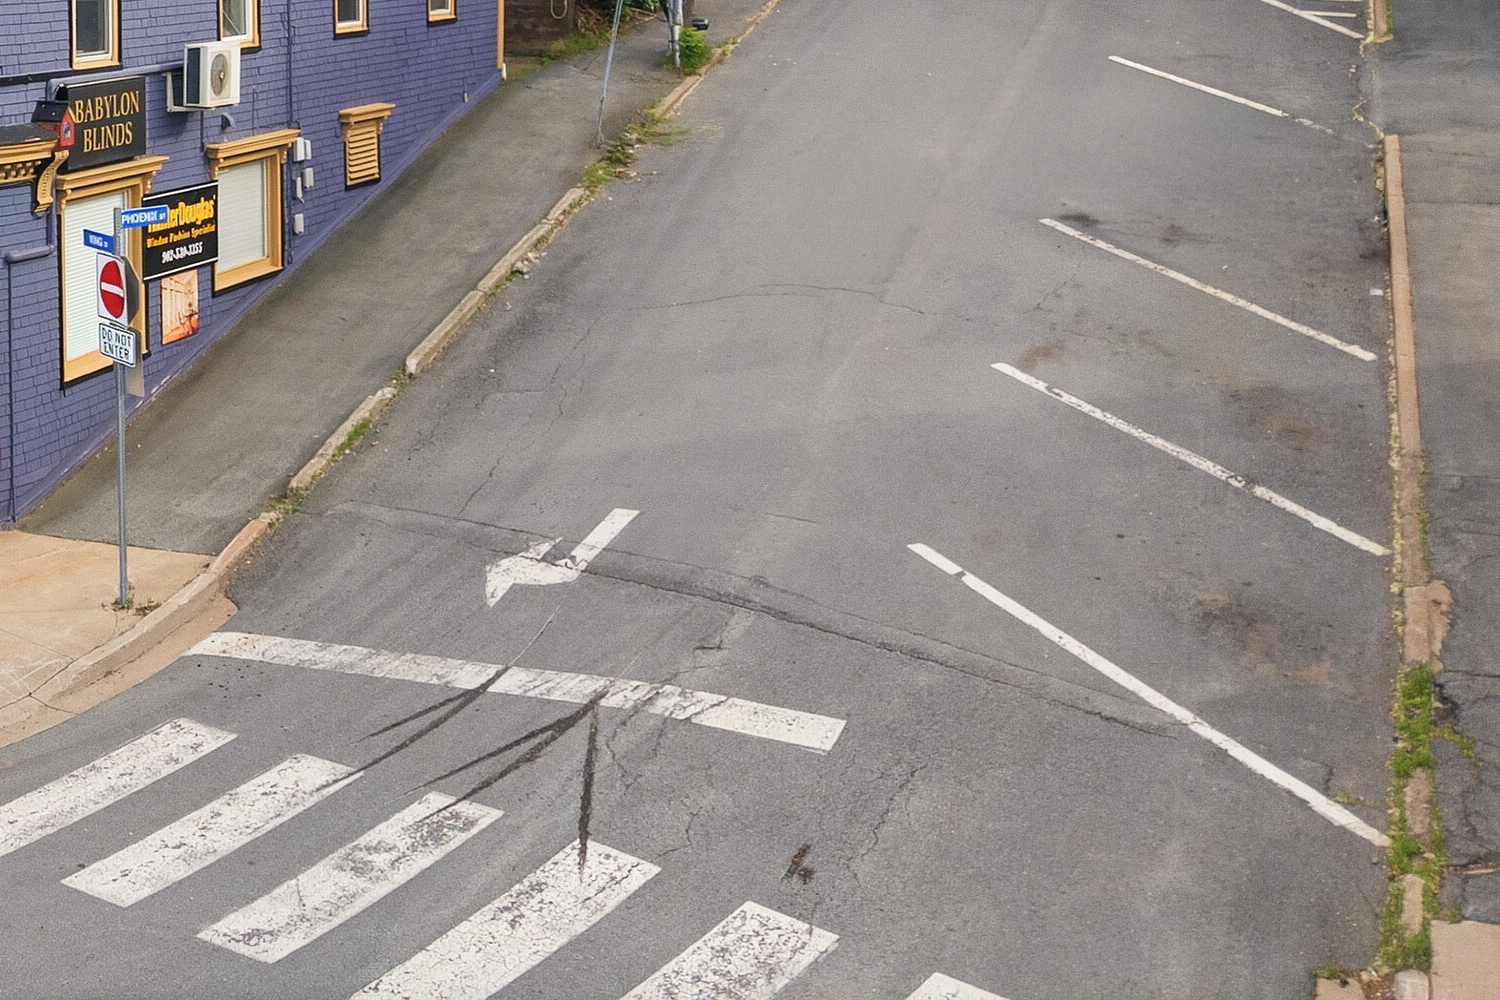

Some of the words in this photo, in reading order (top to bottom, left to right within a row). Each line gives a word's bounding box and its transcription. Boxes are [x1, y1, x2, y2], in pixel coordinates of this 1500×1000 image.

[74, 90, 140, 123] BABYLON
[83, 121, 133, 153] BLINDS
[121, 209, 158, 225] PHOENIX
[101, 327, 113, 341] DO
[115, 332, 131, 347] NOT
[103, 341, 130, 361] ENTER
